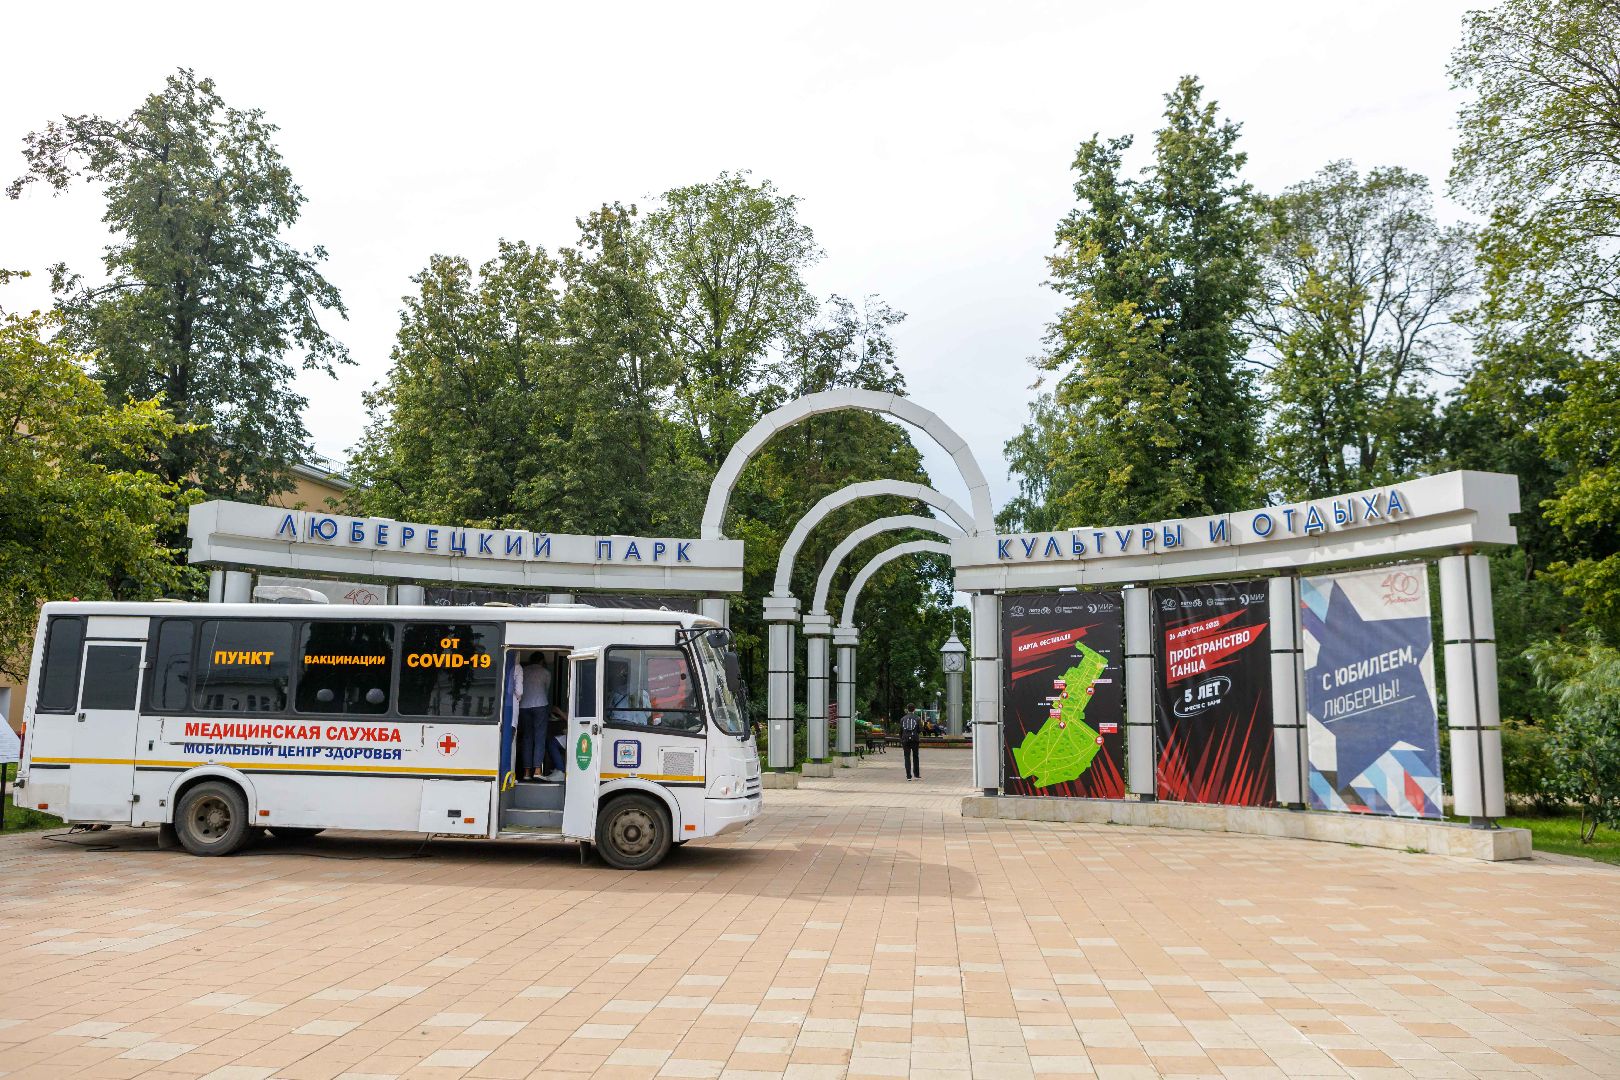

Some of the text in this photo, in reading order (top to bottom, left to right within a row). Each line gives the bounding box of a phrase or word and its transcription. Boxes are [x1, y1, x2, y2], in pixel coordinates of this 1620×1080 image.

[997, 489, 1406, 560] КУЛЬТУРЫ И ОТДЫХА
[277, 513, 692, 564] ЛЮБЕРЕЦКИЙ ПАРК
[1177, 625, 1205, 638] АВГУСТА
[1018, 641, 1039, 652] КАРТА
[1169, 630, 1251, 666] ПРОСТРАНСТВО
[214, 650, 275, 666] ПУНКТ
[304, 655, 386, 667] ВАКЦИНАЦИИ
[407, 652, 491, 669] COVID-19
[1322, 645, 1419, 691] С ЮБИЛЕЕМ,
[1170, 659, 1206, 678] ТАНЦА
[1184, 681, 1221, 703] 5 ЛЕТ
[1323, 678, 1401, 720] ЛЮБЕРЦЫ!
[184, 722, 402, 743] МЕДИЦИНСКАЯ СЛУЖБА
[183, 741, 402, 761] МОБИЛЬНЫЙ ЦЕНТР ЗДОРОВЬЯ
